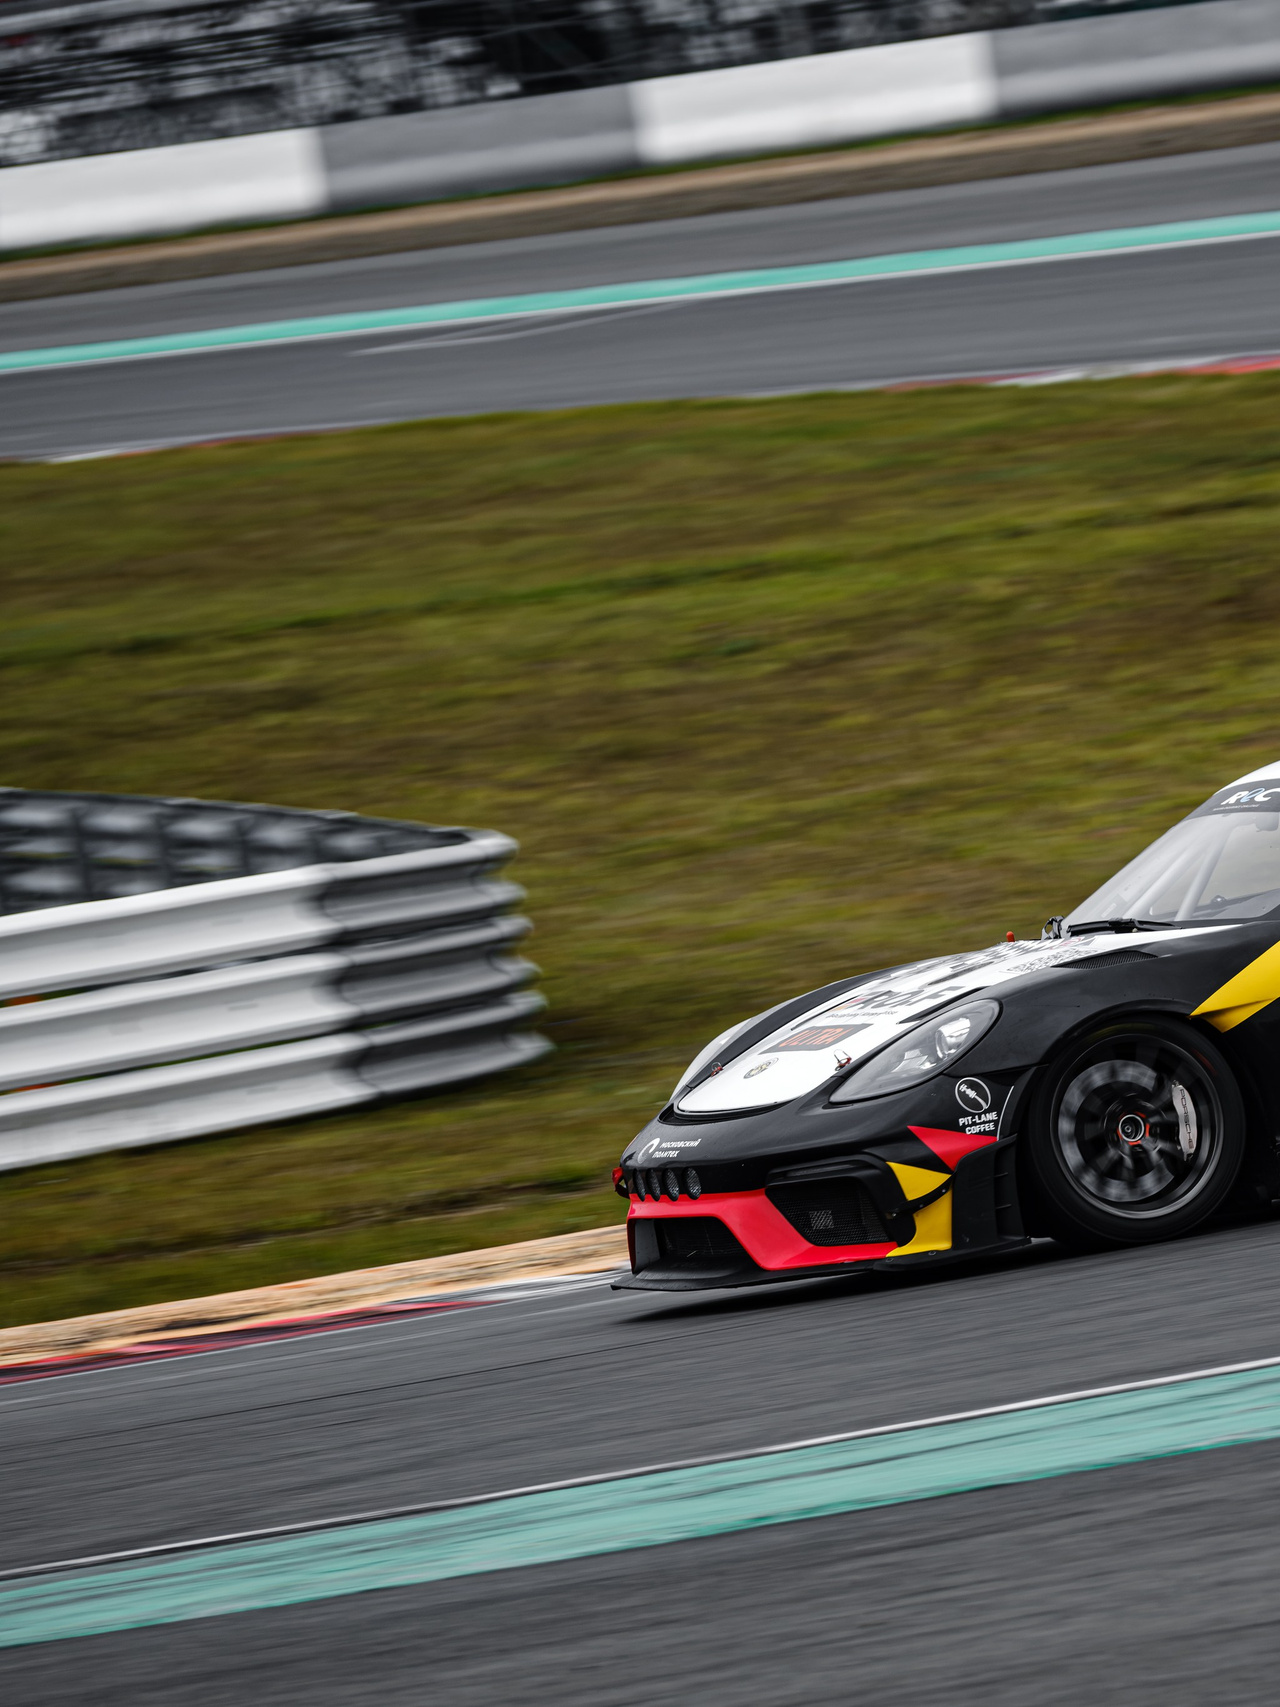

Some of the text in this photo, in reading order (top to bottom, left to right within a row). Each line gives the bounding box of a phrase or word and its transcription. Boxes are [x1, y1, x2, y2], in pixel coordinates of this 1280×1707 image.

[958, 1111, 999, 1127] PIT-LANE
[1179, 1088, 1195, 1150] PORSCHE
[965, 1122, 996, 1135] COFFEE
